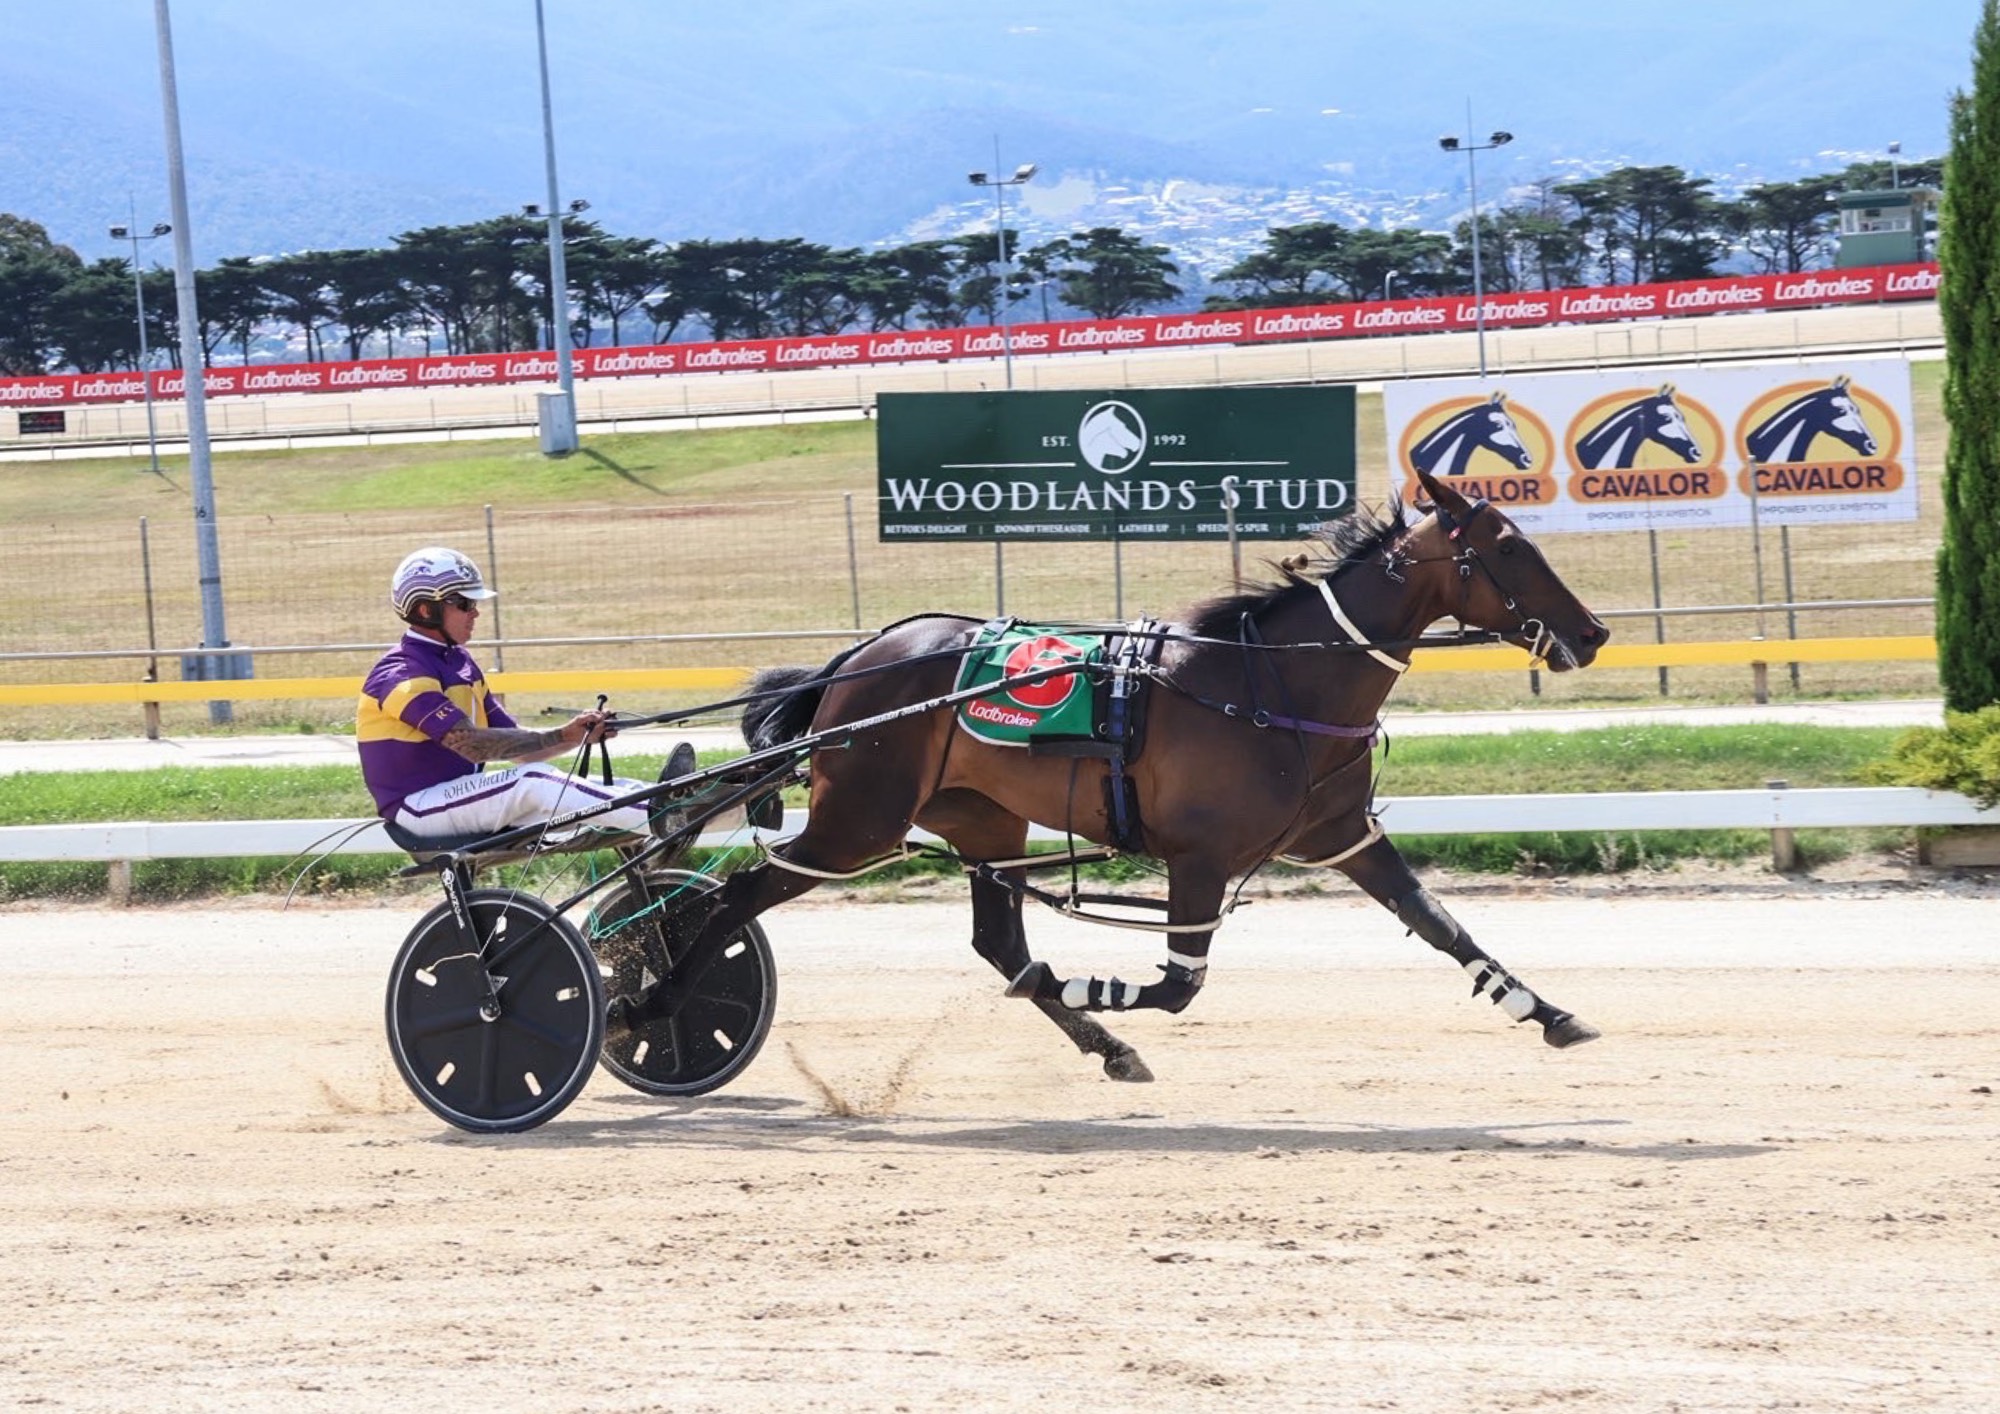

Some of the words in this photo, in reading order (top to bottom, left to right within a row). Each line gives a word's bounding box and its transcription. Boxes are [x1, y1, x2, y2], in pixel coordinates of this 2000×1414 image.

[0, 382, 64, 400] adbrokes
[72, 378, 147, 396] Ladbrokes
[157, 373, 235, 393] Ladokes
[244, 369, 320, 388] Ladbrokes
[329, 365, 407, 383] Ladbrokes
[417, 361, 496, 380] Ladbrokes
[504, 356, 585, 377] Ladbroes
[593, 351, 674, 371] Ladbrokes
[685, 347, 766, 366] Ladbrokes
[775, 342, 859, 361] Ladbrokes
[868, 336, 952, 356] Ladbrokes
[1058, 326, 1145, 346] Ladbrokes
[1155, 319, 1242, 339] Ladbrokes
[1254, 312, 1343, 333] Ladbrokes
[1353, 306, 1445, 327] Ladbrokes
[1456, 299, 1548, 321] Ladbrokes
[1560, 292, 1655, 314] Ladbrokes
[1665, 285, 1763, 307] Ladbrokes
[1774, 277, 1873, 299] Ladbrokes
[1886, 270, 1942, 292] Ladbr
[1042, 435, 1071, 448] EST.
[1153, 434, 1187, 447] 1992
[1415, 479, 1540, 502] CVALOR
[1581, 472, 1711, 498] CAVALOR
[1755, 465, 1886, 492] CAVALOR
[885, 477, 1196, 512] WOODLANDS
[1220, 474, 1348, 510] STUD
[1586, 510, 1636, 521] EMPOWER
[1665, 508, 1712, 518] AMBITION
[1758, 504, 1808, 515] EMPOWER
[1810, 503, 1837, 514] YOUR
[1839, 502, 1888, 512] AMBITION
[1196, 523, 1243, 533] SPEEDIG
[1004, 635, 1084, 709] 6
[968, 700, 1038, 727] Ladbrokes
